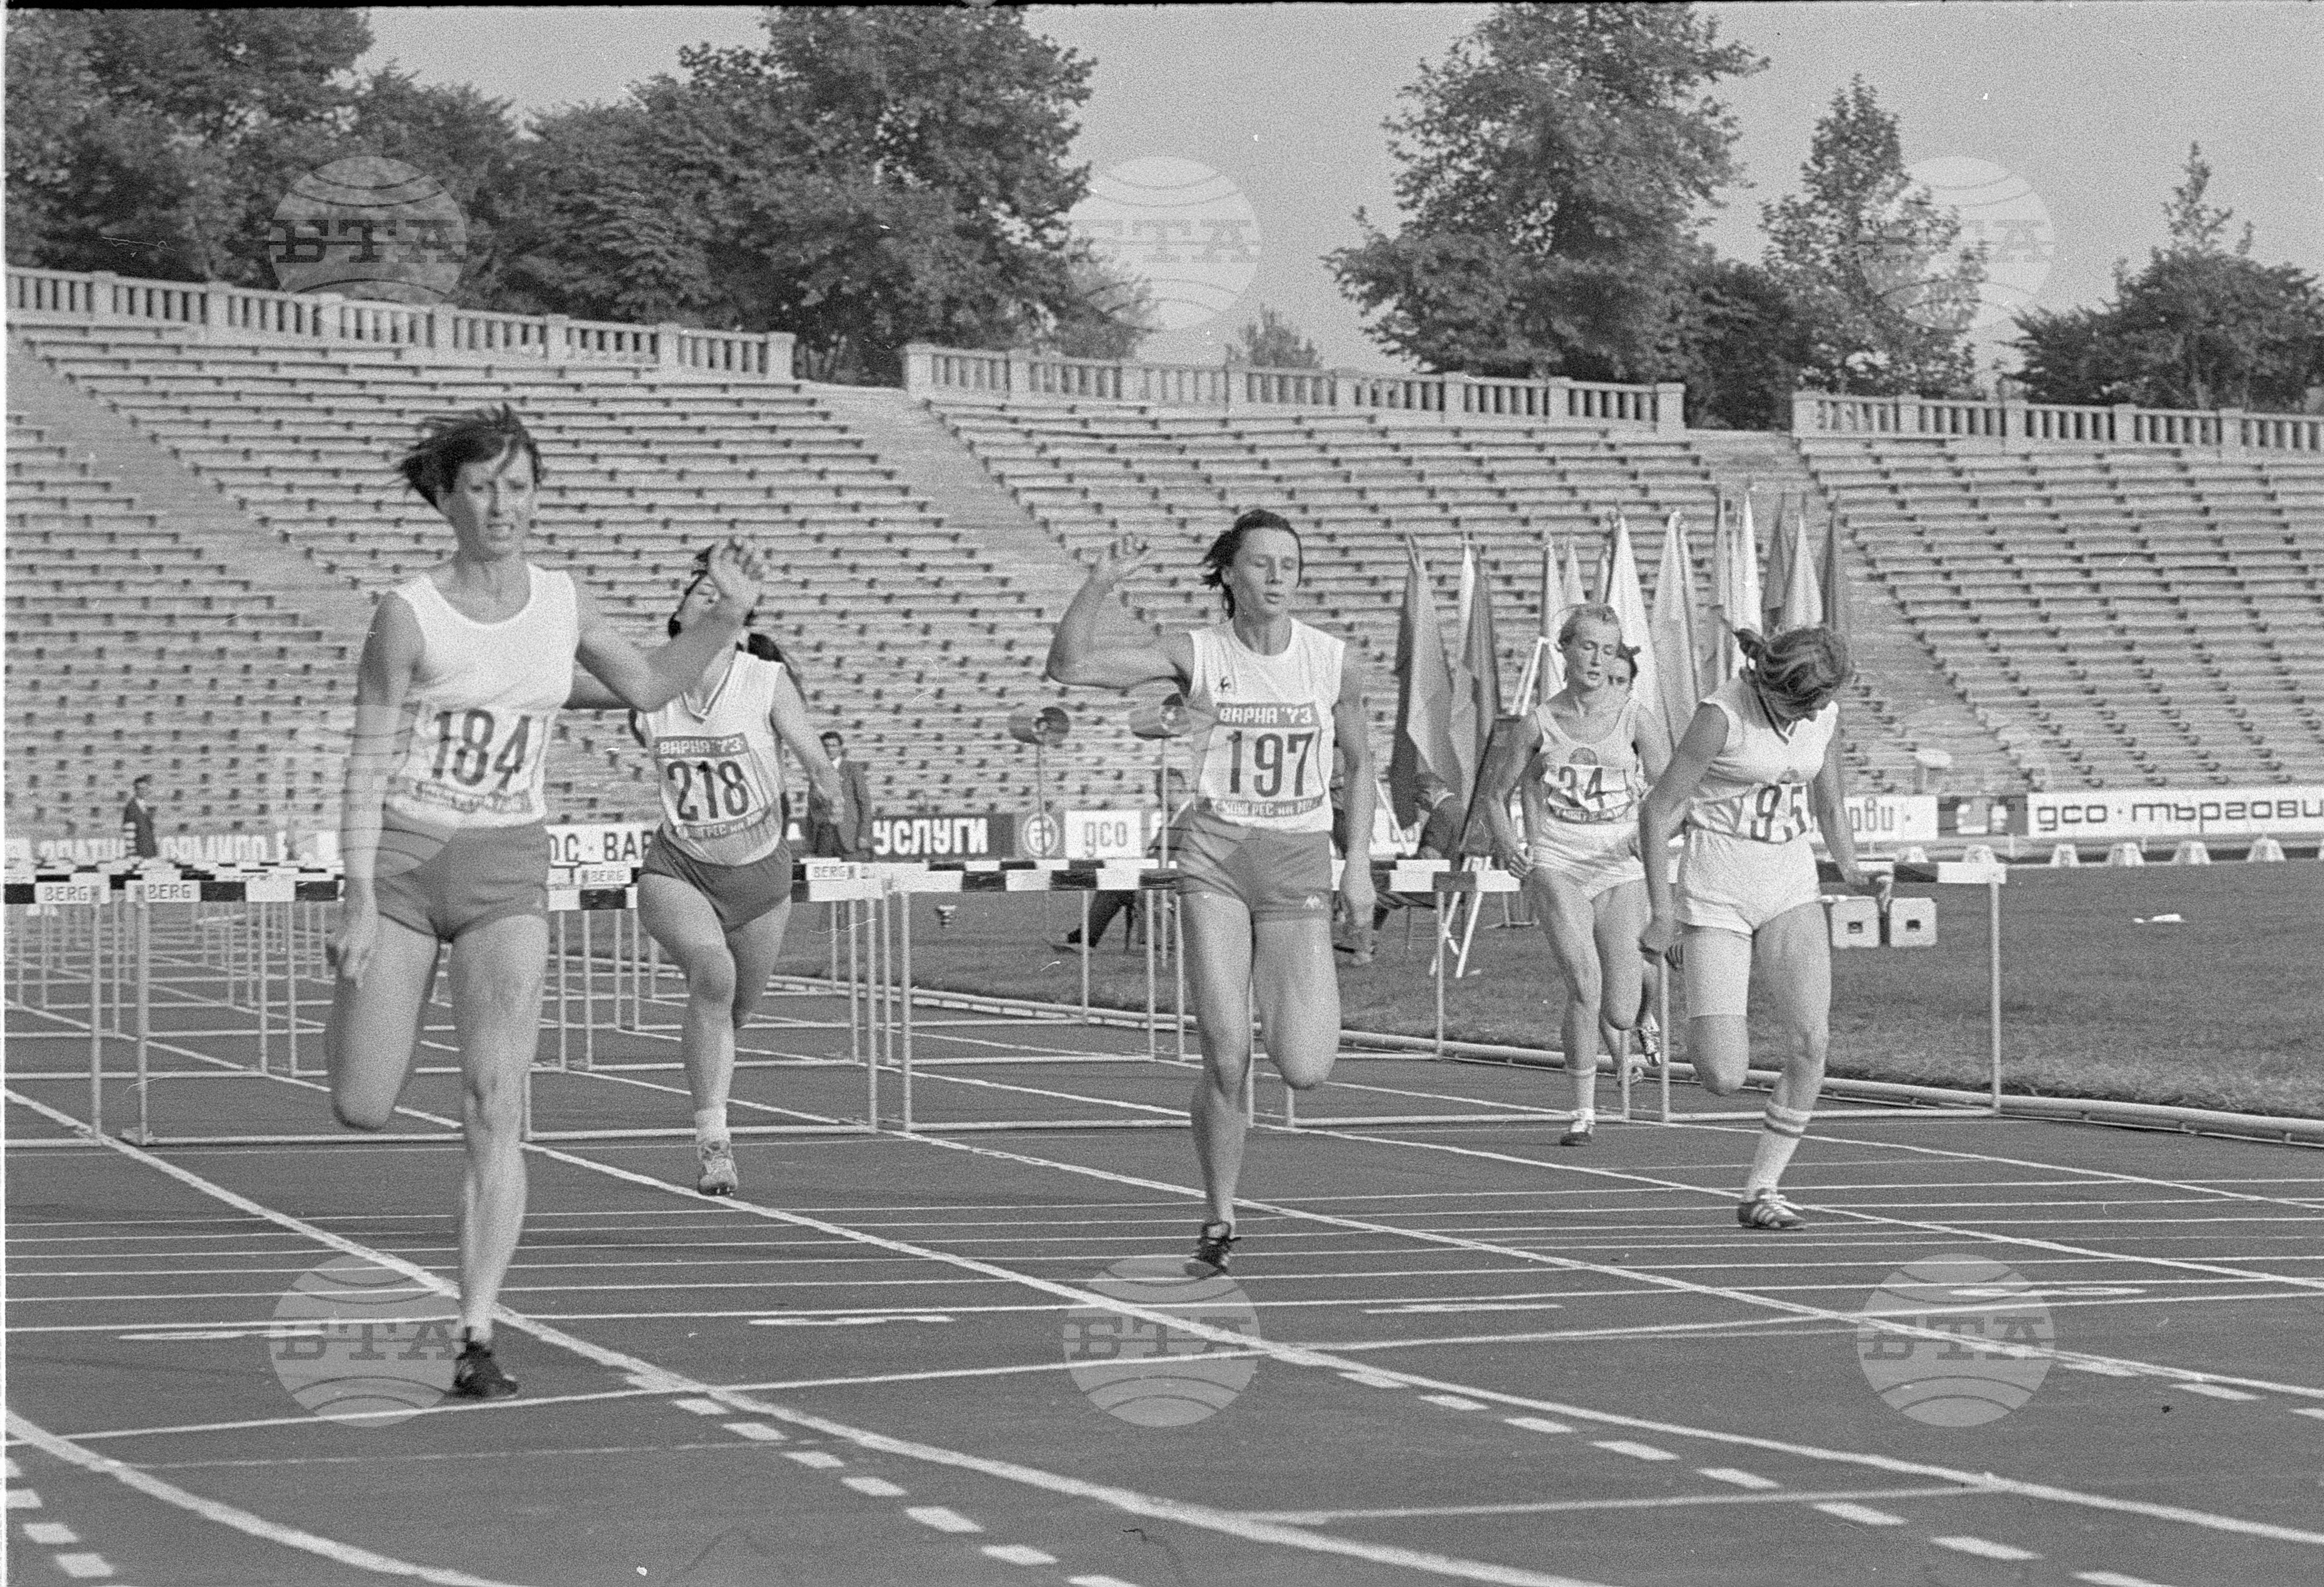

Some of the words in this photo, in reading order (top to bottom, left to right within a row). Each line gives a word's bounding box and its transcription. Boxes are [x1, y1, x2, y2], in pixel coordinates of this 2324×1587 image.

[432, 707, 532, 789] 184
[1226, 730, 1314, 798] 197
[667, 760, 749, 821] 218
[872, 818, 987, 855] УСЛУГИ
[44, 886, 88, 901] BERG
[148, 884, 192, 900] BERG
